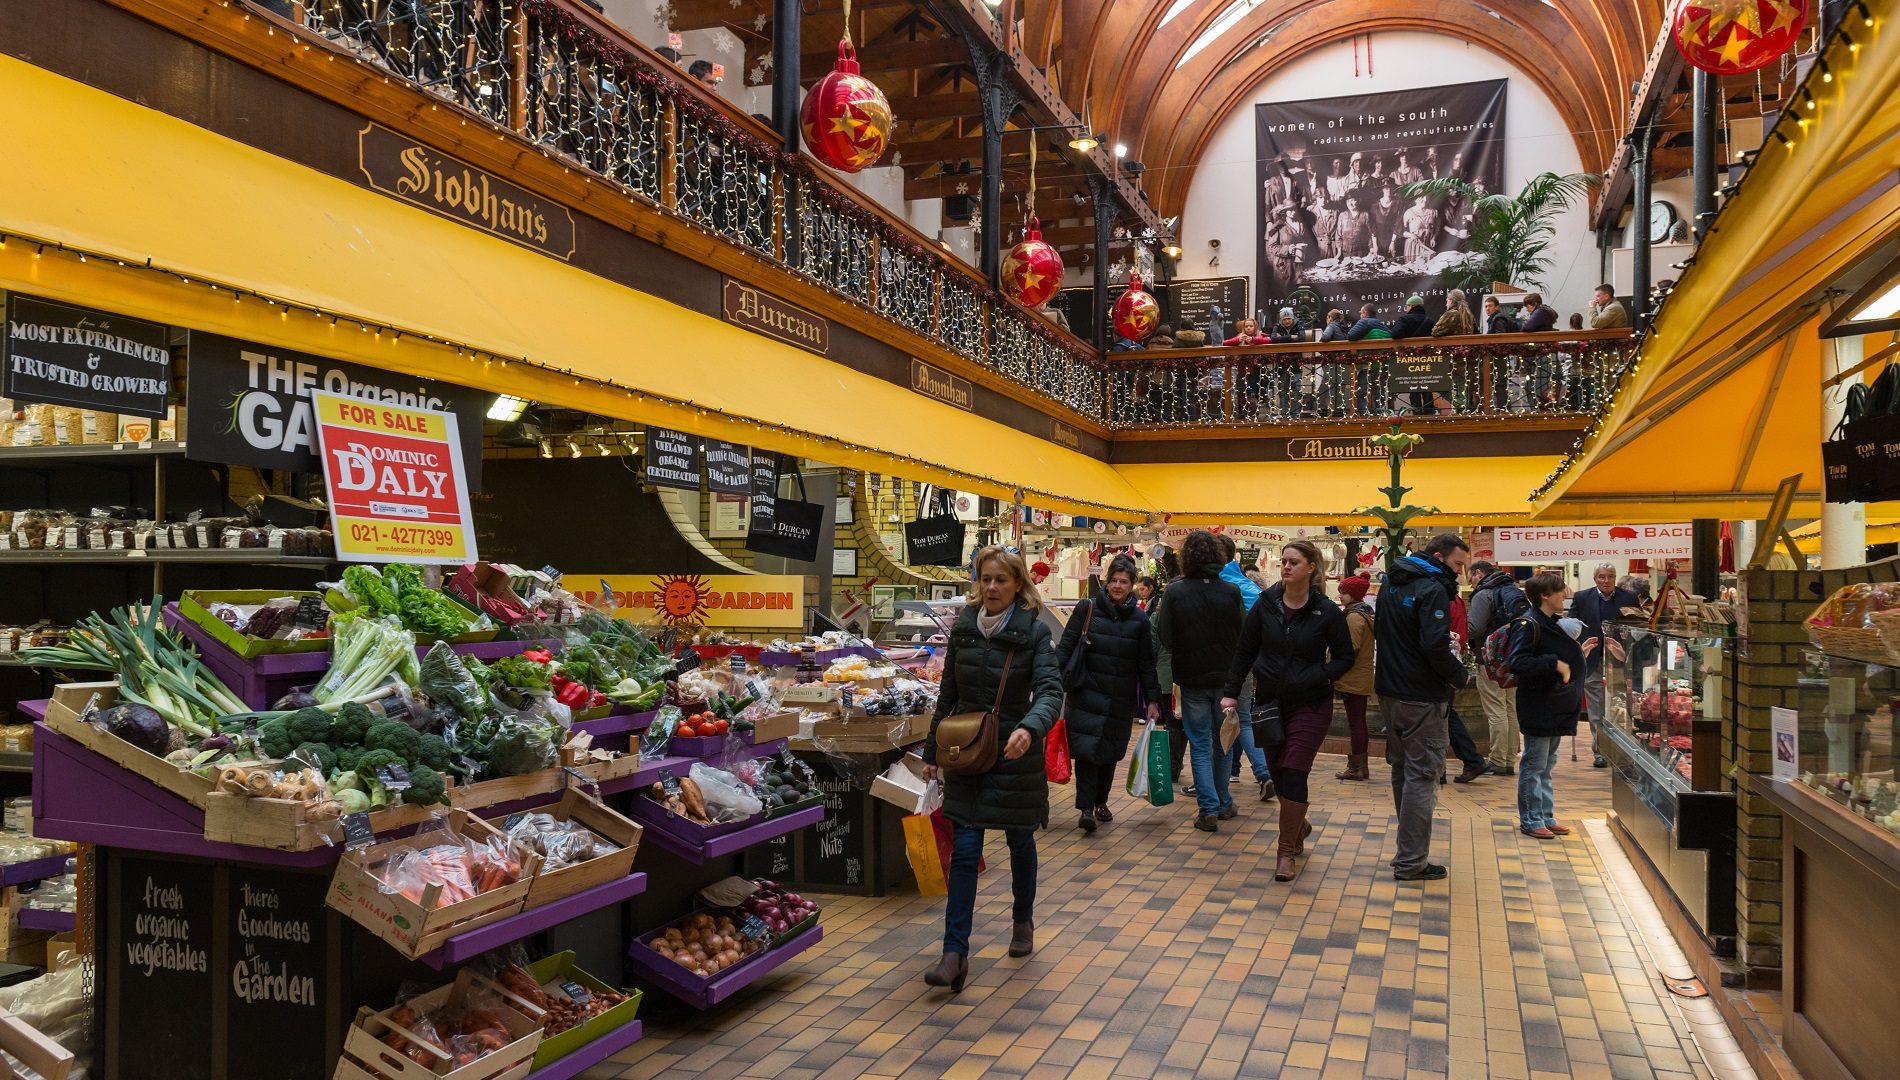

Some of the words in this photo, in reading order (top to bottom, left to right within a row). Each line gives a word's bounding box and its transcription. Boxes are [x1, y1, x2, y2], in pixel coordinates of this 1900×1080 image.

[1269, 121, 1315, 133] women
[1328, 116, 1345, 129] of
[1358, 114, 1385, 126] the
[1399, 107, 1448, 121] south
[1313, 134, 1363, 145] radicals
[1371, 131, 1389, 140] and
[1397, 121, 1494, 138] revolutionaries
[1361, 291, 1405, 301] english
[736, 288, 822, 344] Durcan
[10, 320, 60, 343] MOST
[62, 327, 169, 366] EXPERIENCED
[87, 353, 101, 370] &
[1396, 355, 1443, 364] FARMGATE
[1408, 364, 1431, 373] CAFÉ
[11, 355, 89, 388] TRUSTED
[91, 374, 168, 396] GROWERS
[241, 350, 318, 397] THE
[916, 364, 967, 406] Moynihan
[339, 403, 377, 426] FOR
[383, 411, 428, 433] SALE
[348, 442, 439, 468] DOMINIC
[655, 439, 693, 456] UNFLAWED
[1856, 443, 1875, 455] TOM
[658, 455, 689, 470] ORGANIC
[333, 449, 448, 499] DALY
[647, 465, 700, 483] CERTIFICATION
[730, 473, 748, 486] DATES
[779, 522, 811, 535] DURCAN
[779, 531, 806, 540] MARKET
[1234, 528, 1285, 542] POULTRY
[1499, 530, 1599, 541] STEPHEN'S
[913, 537, 926, 546] TOM
[927, 533, 949, 543] DURCAN
[1589, 548, 1620, 556] PORK
[1623, 547, 1690, 555] SPECIALIST
[705, 591, 794, 610] GARDEN
[823, 793, 843, 809] ruits
[821, 833, 843, 859] Nuts
[142, 876, 183, 910] fresh
[135, 912, 189, 945] organic
[237, 908, 311, 943] Goodness
[128, 941, 207, 977] vegetables
[233, 959, 316, 1006] Garden
